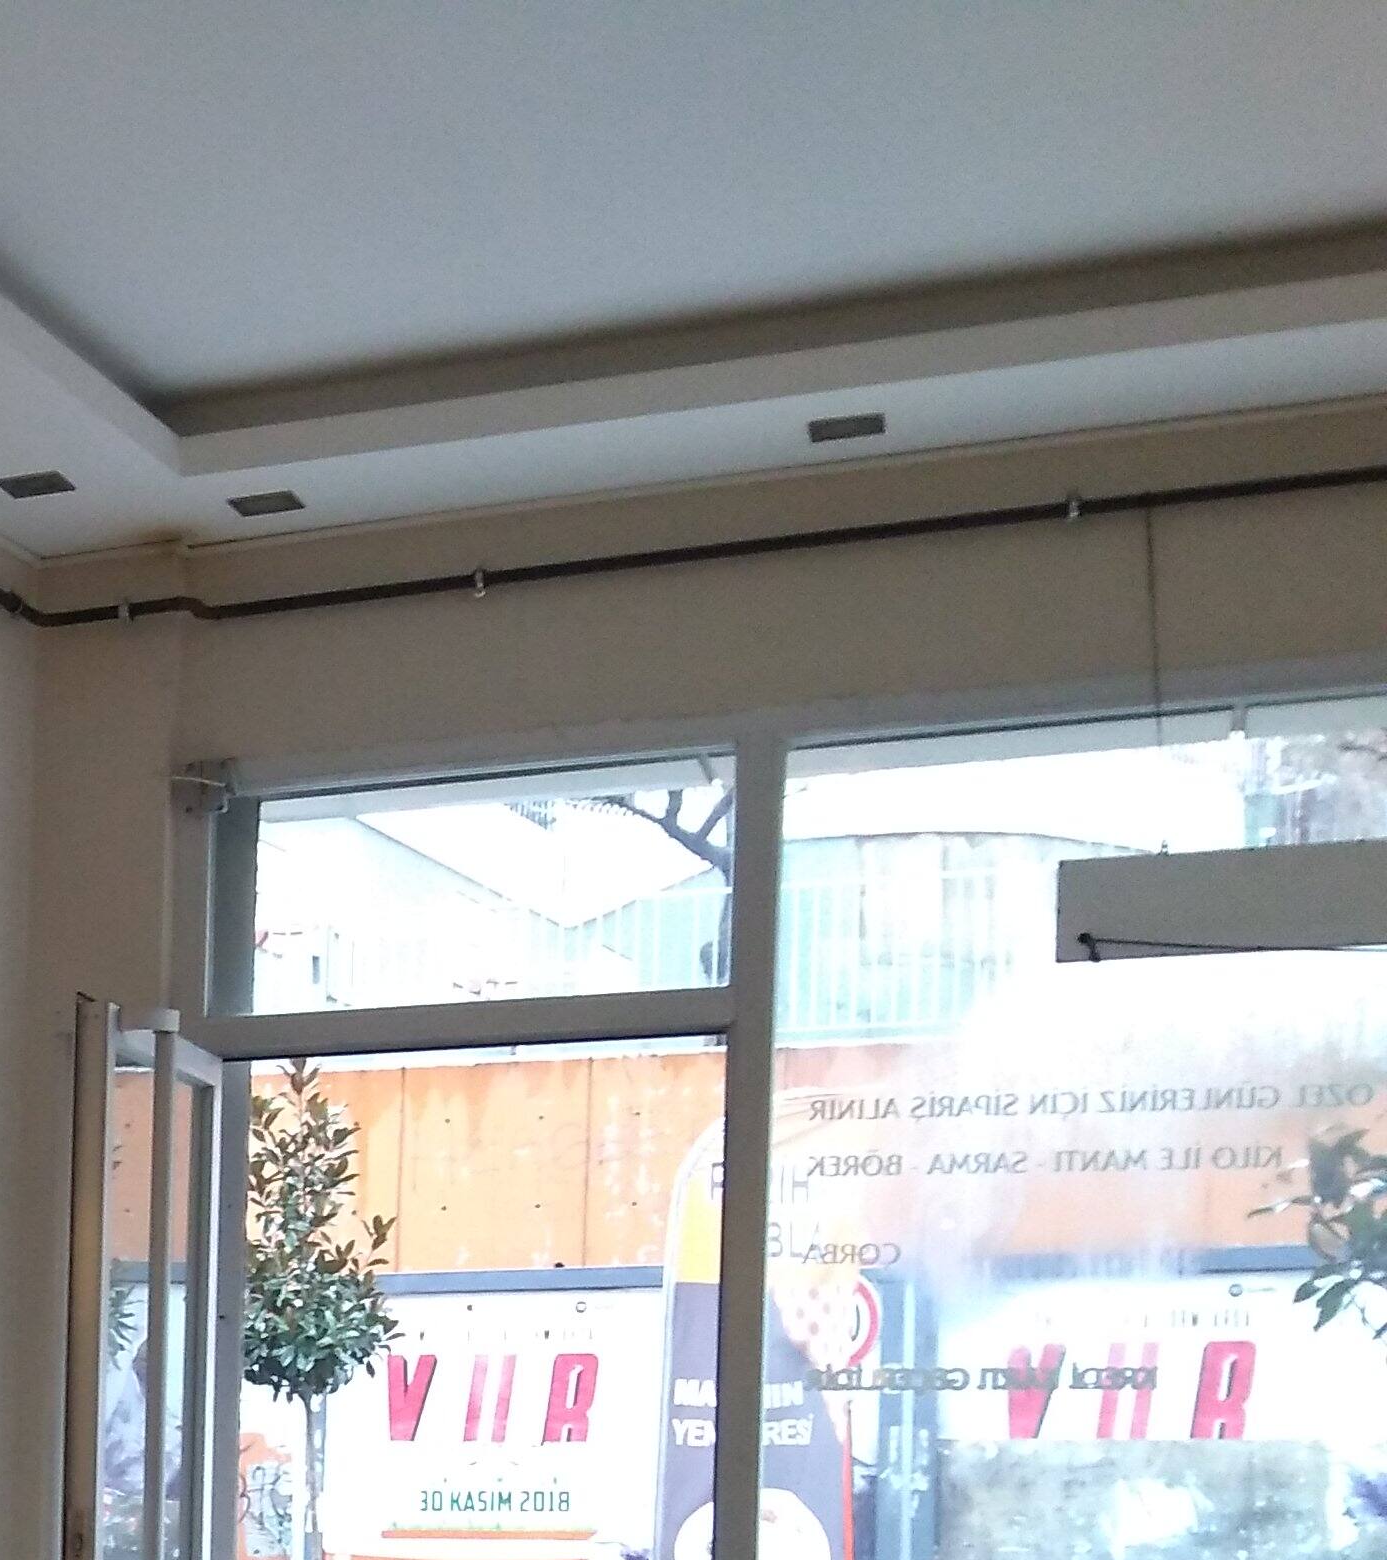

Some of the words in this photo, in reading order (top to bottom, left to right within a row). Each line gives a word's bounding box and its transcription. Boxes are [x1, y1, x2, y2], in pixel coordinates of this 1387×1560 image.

[420, 1490, 443, 1512] 30
[450, 1490, 512, 1512] KASIM
[520, 1490, 571, 1512] 2018
